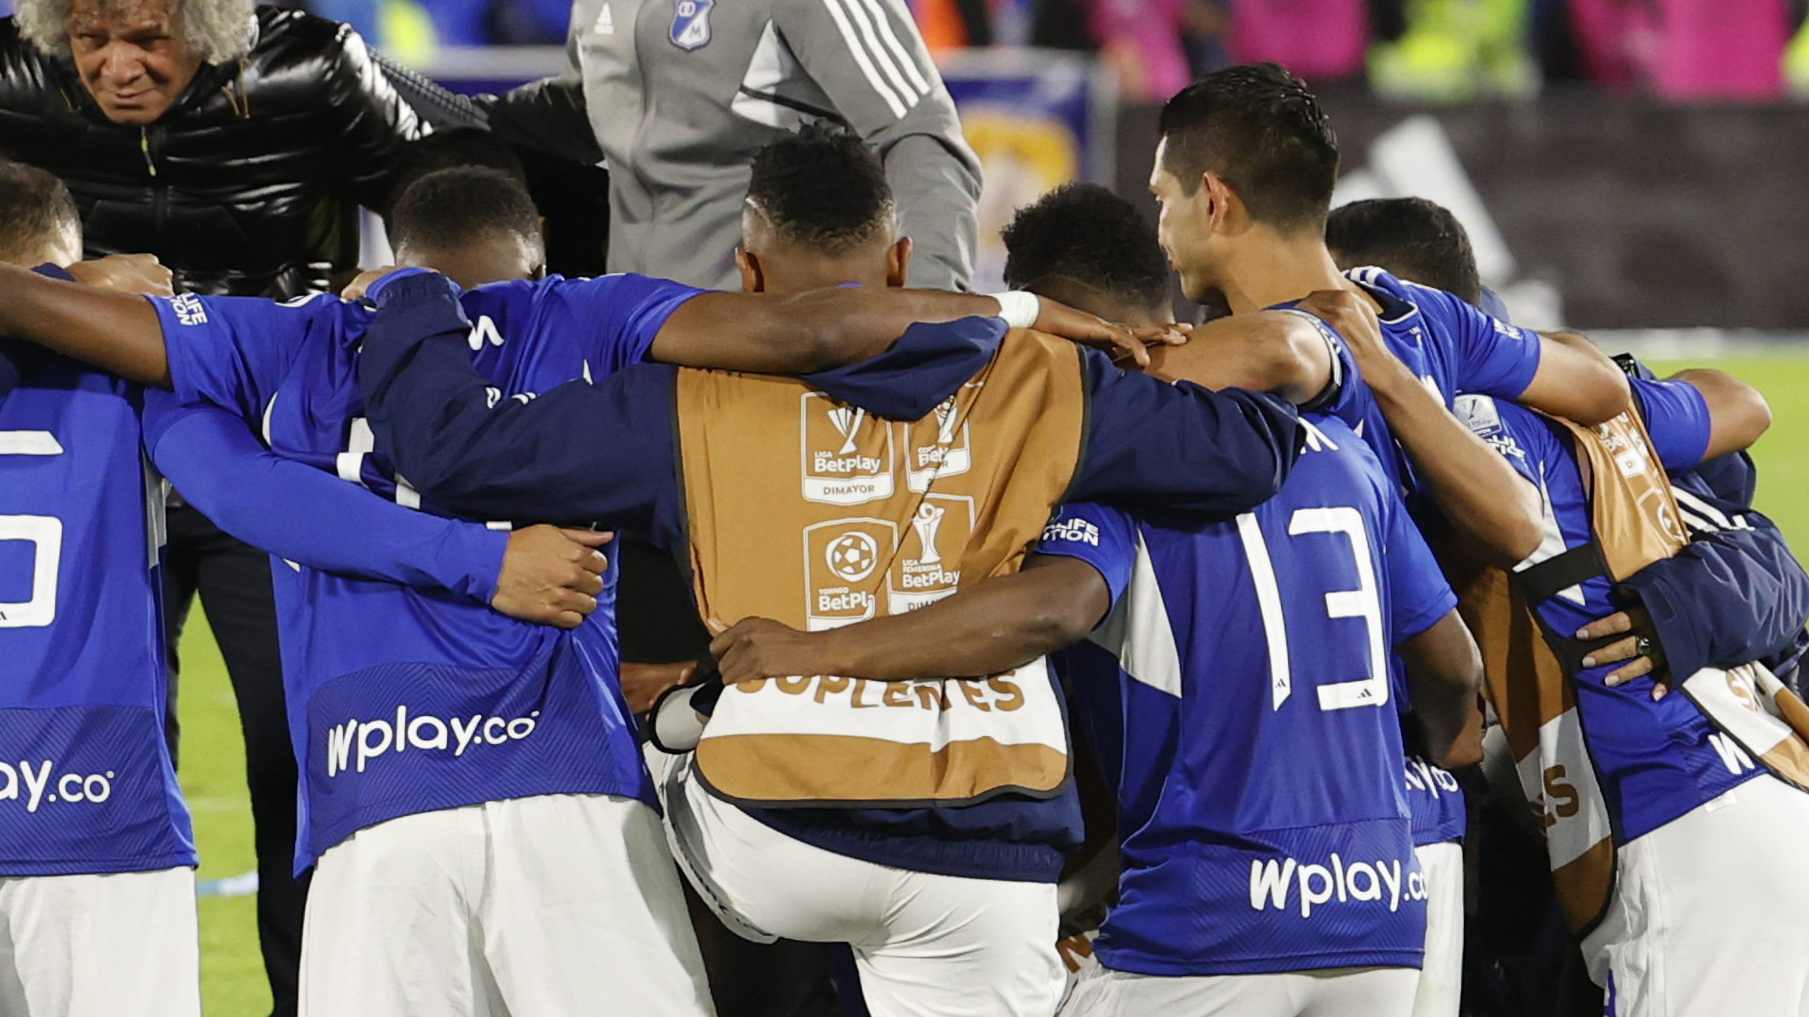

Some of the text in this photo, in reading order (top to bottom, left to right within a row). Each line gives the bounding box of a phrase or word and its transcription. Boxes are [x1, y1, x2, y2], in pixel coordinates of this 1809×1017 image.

[178, 292, 208, 326] LIFE
[814, 451, 833, 459] LIGA
[814, 455, 882, 474] BetPlay
[823, 485, 876, 496] DIMAYOR
[902, 570, 961, 588] BetPlay
[818, 587, 850, 595] TORNEO
[818, 591, 869, 612] BetPl
[1236, 507, 1389, 712] 13
[328, 705, 537, 777] Wplay.co
